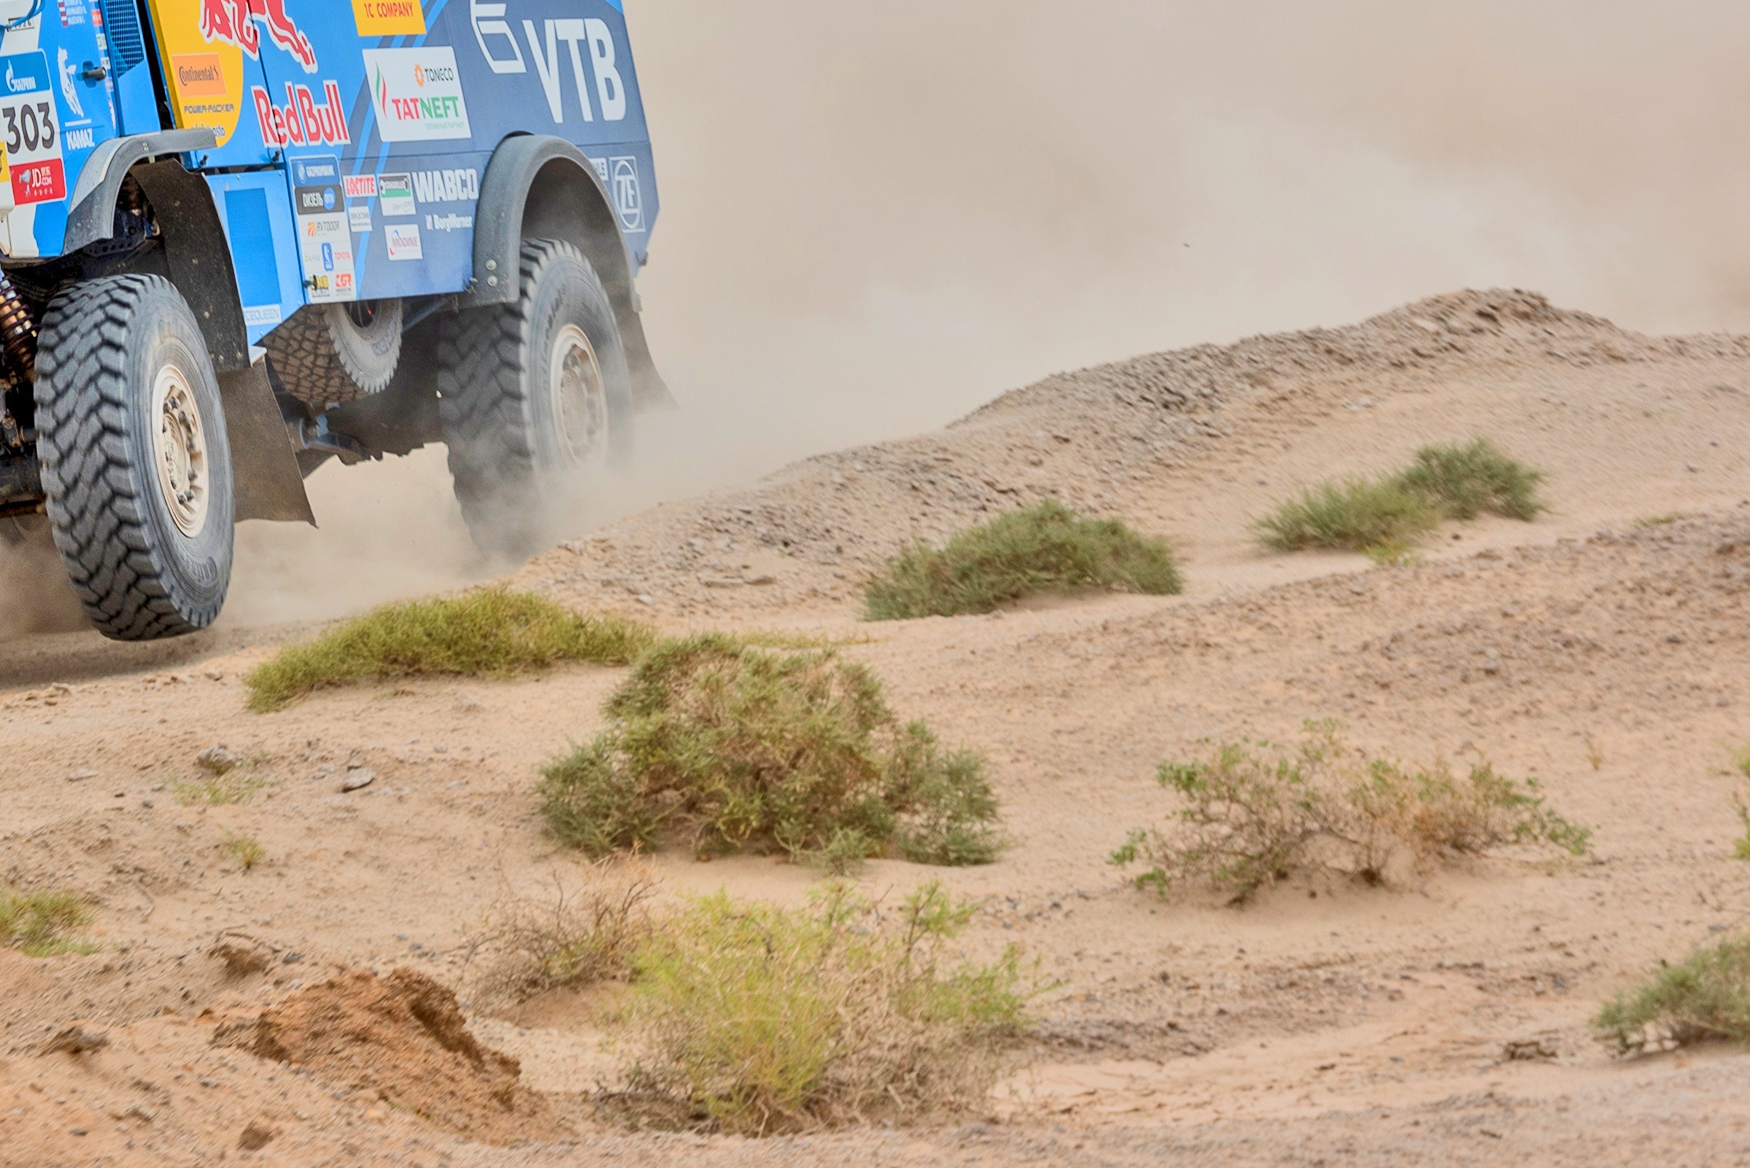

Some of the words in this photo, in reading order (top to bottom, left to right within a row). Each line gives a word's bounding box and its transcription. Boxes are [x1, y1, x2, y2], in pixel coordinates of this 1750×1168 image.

[364, 2, 375, 19] 1C
[376, 1, 415, 19] COMPANY
[178, 65, 215, 87] Continental
[522, 17, 627, 125] VTB
[183, 103, 235, 115] POWER-PACKER
[253, 84, 305, 145] Red
[296, 83, 349, 143] Bull
[391, 96, 460, 121] TATNEFT
[2, 101, 55, 155] 303
[65, 128, 95, 151] KAMAZ
[345, 177, 376, 196] LOCTITE
[412, 169, 479, 204] WABCO
[433, 213, 473, 233] BorgWarner
[391, 236, 419, 248] MODINE
